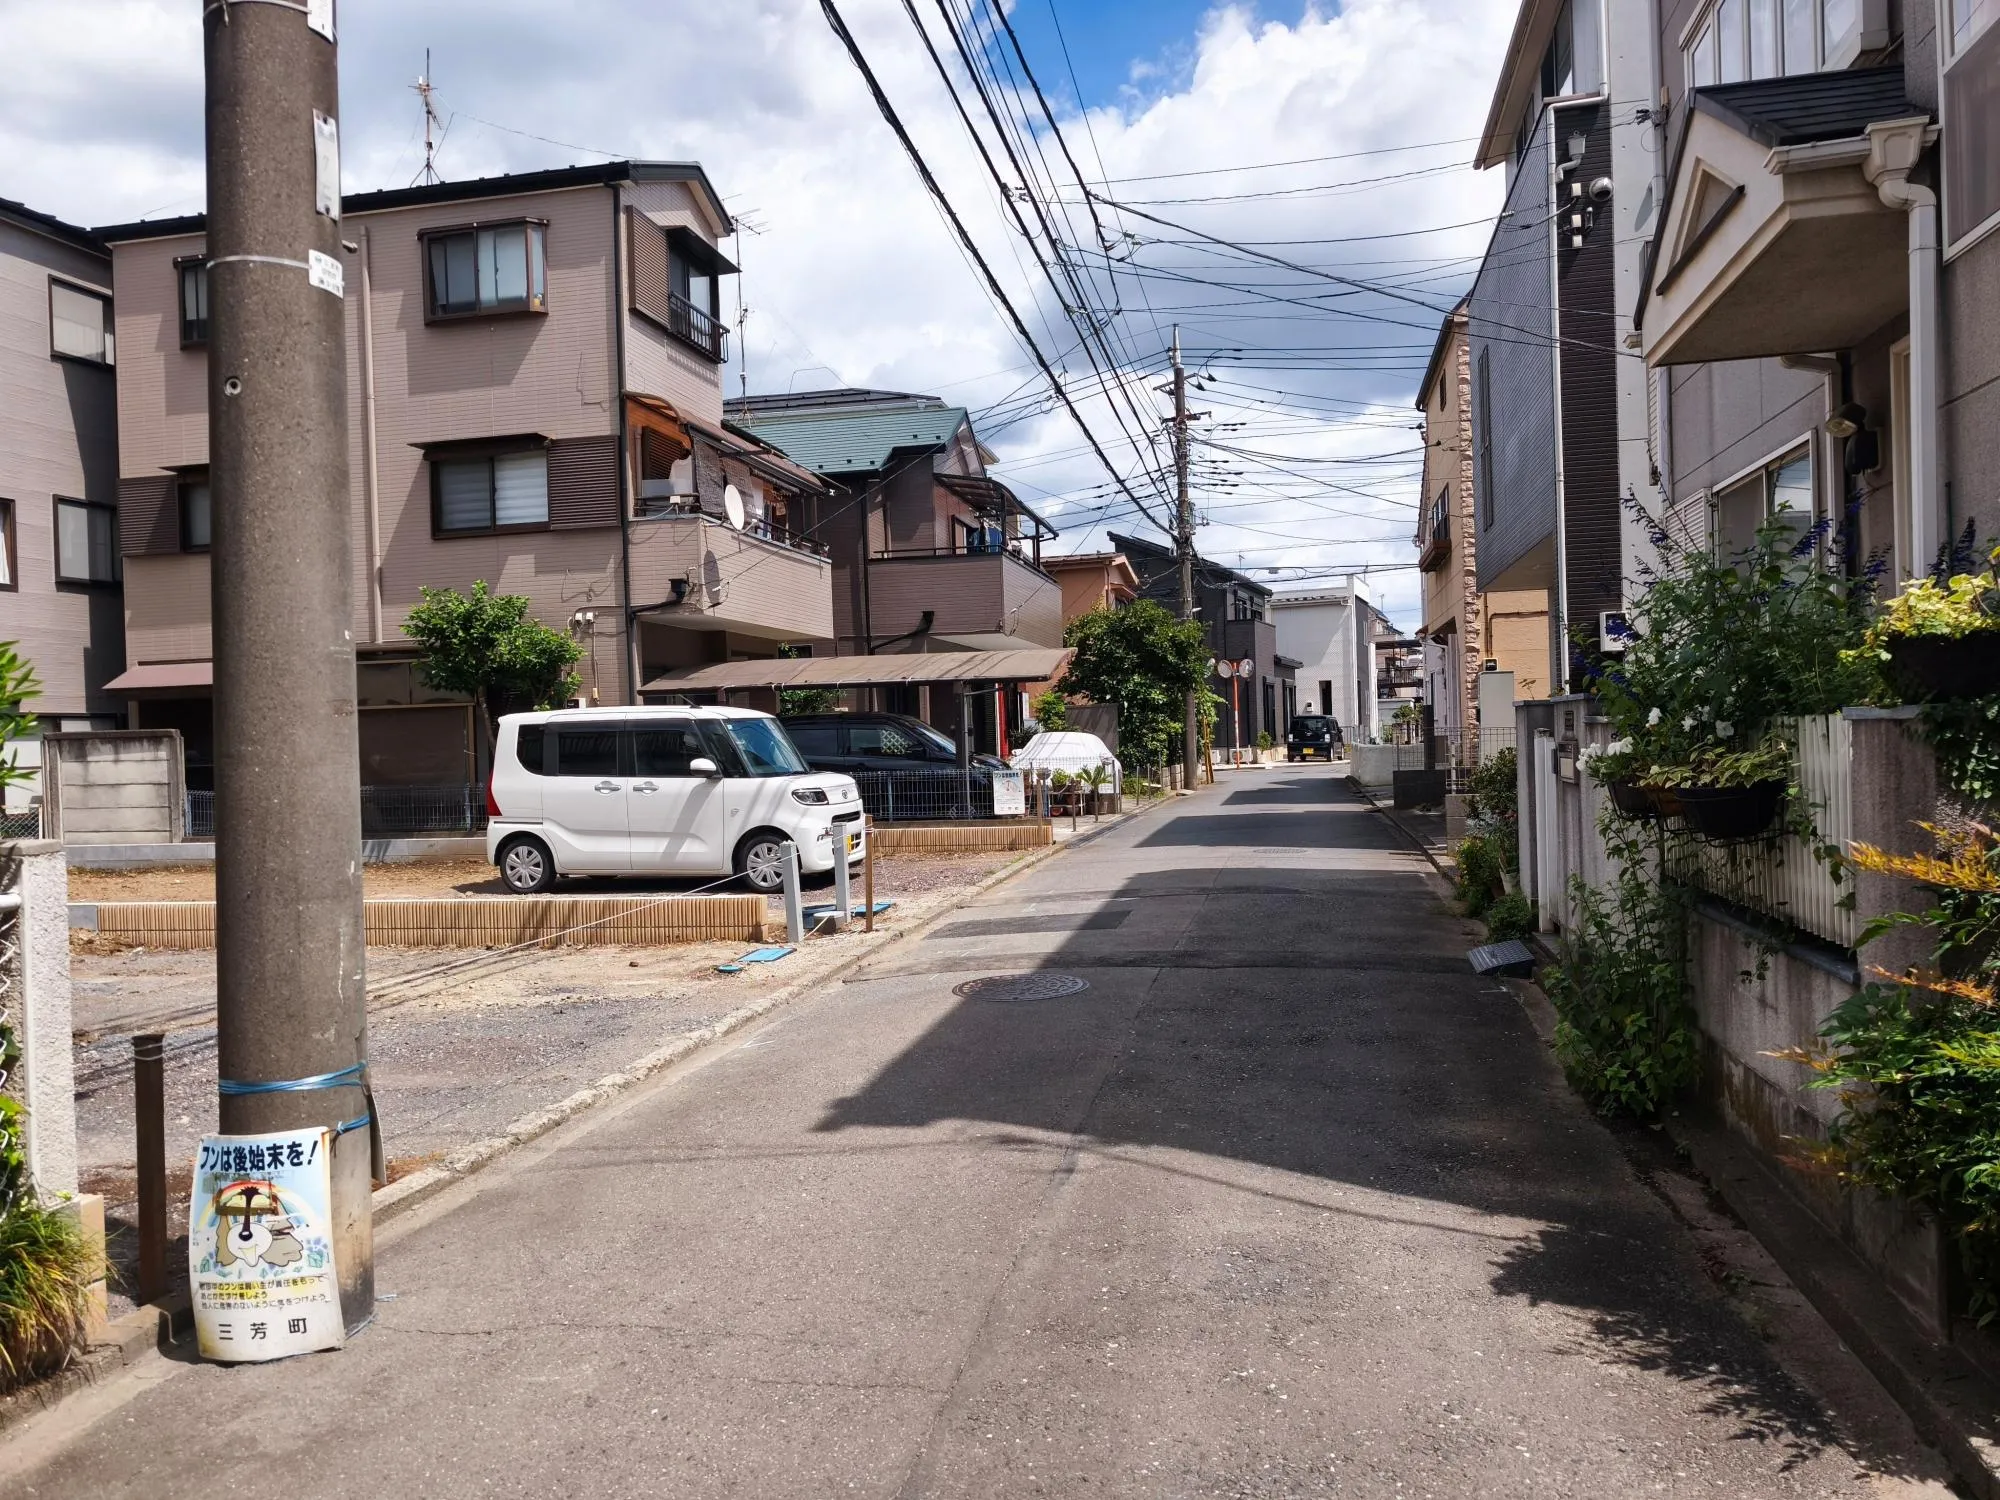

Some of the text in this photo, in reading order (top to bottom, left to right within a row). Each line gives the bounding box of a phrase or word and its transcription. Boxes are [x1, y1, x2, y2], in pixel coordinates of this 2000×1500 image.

[200, 1140, 318, 1172] フンは後始末を!
[218, 1317, 307, 1341] 三芳町
